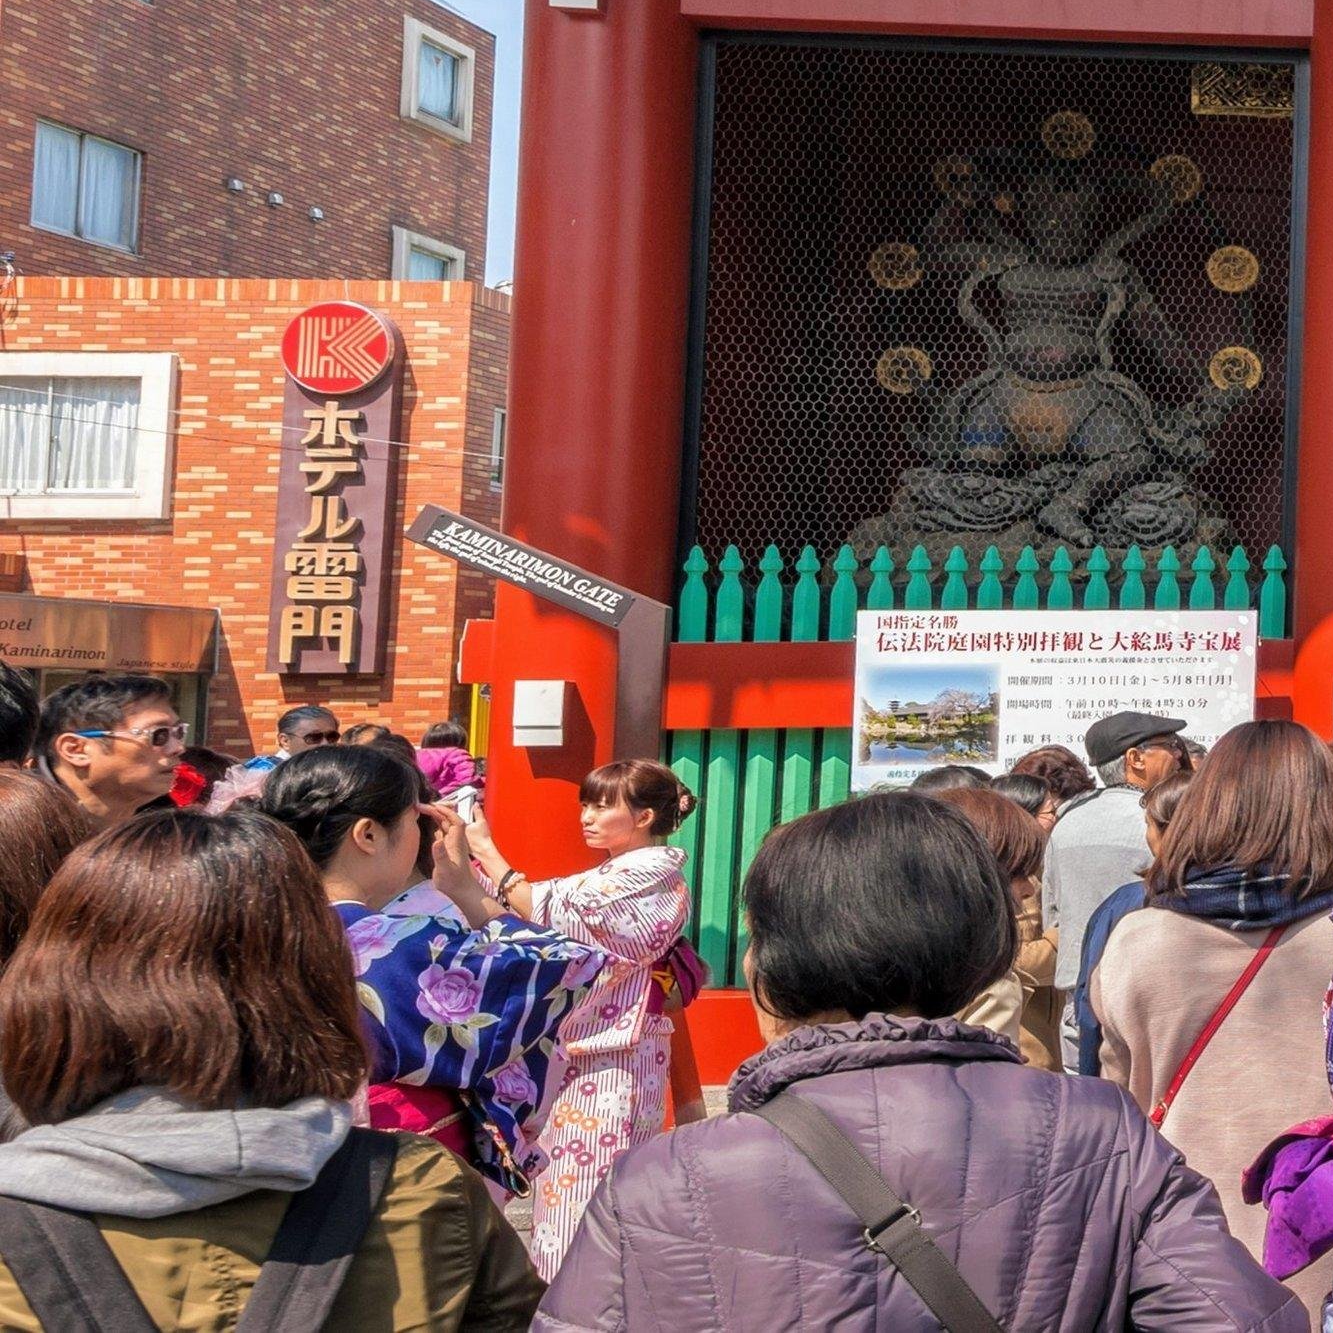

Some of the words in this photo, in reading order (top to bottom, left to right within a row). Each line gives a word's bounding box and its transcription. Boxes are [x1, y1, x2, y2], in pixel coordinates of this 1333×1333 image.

[279, 400, 364, 665] ホテル雷門
[443, 521, 574, 585] KAMINARIMON
[574, 578, 623, 607] GATE
[877, 615, 959, 629] 国指定名勝
[0, 643, 106, 660] Kaminarimon
